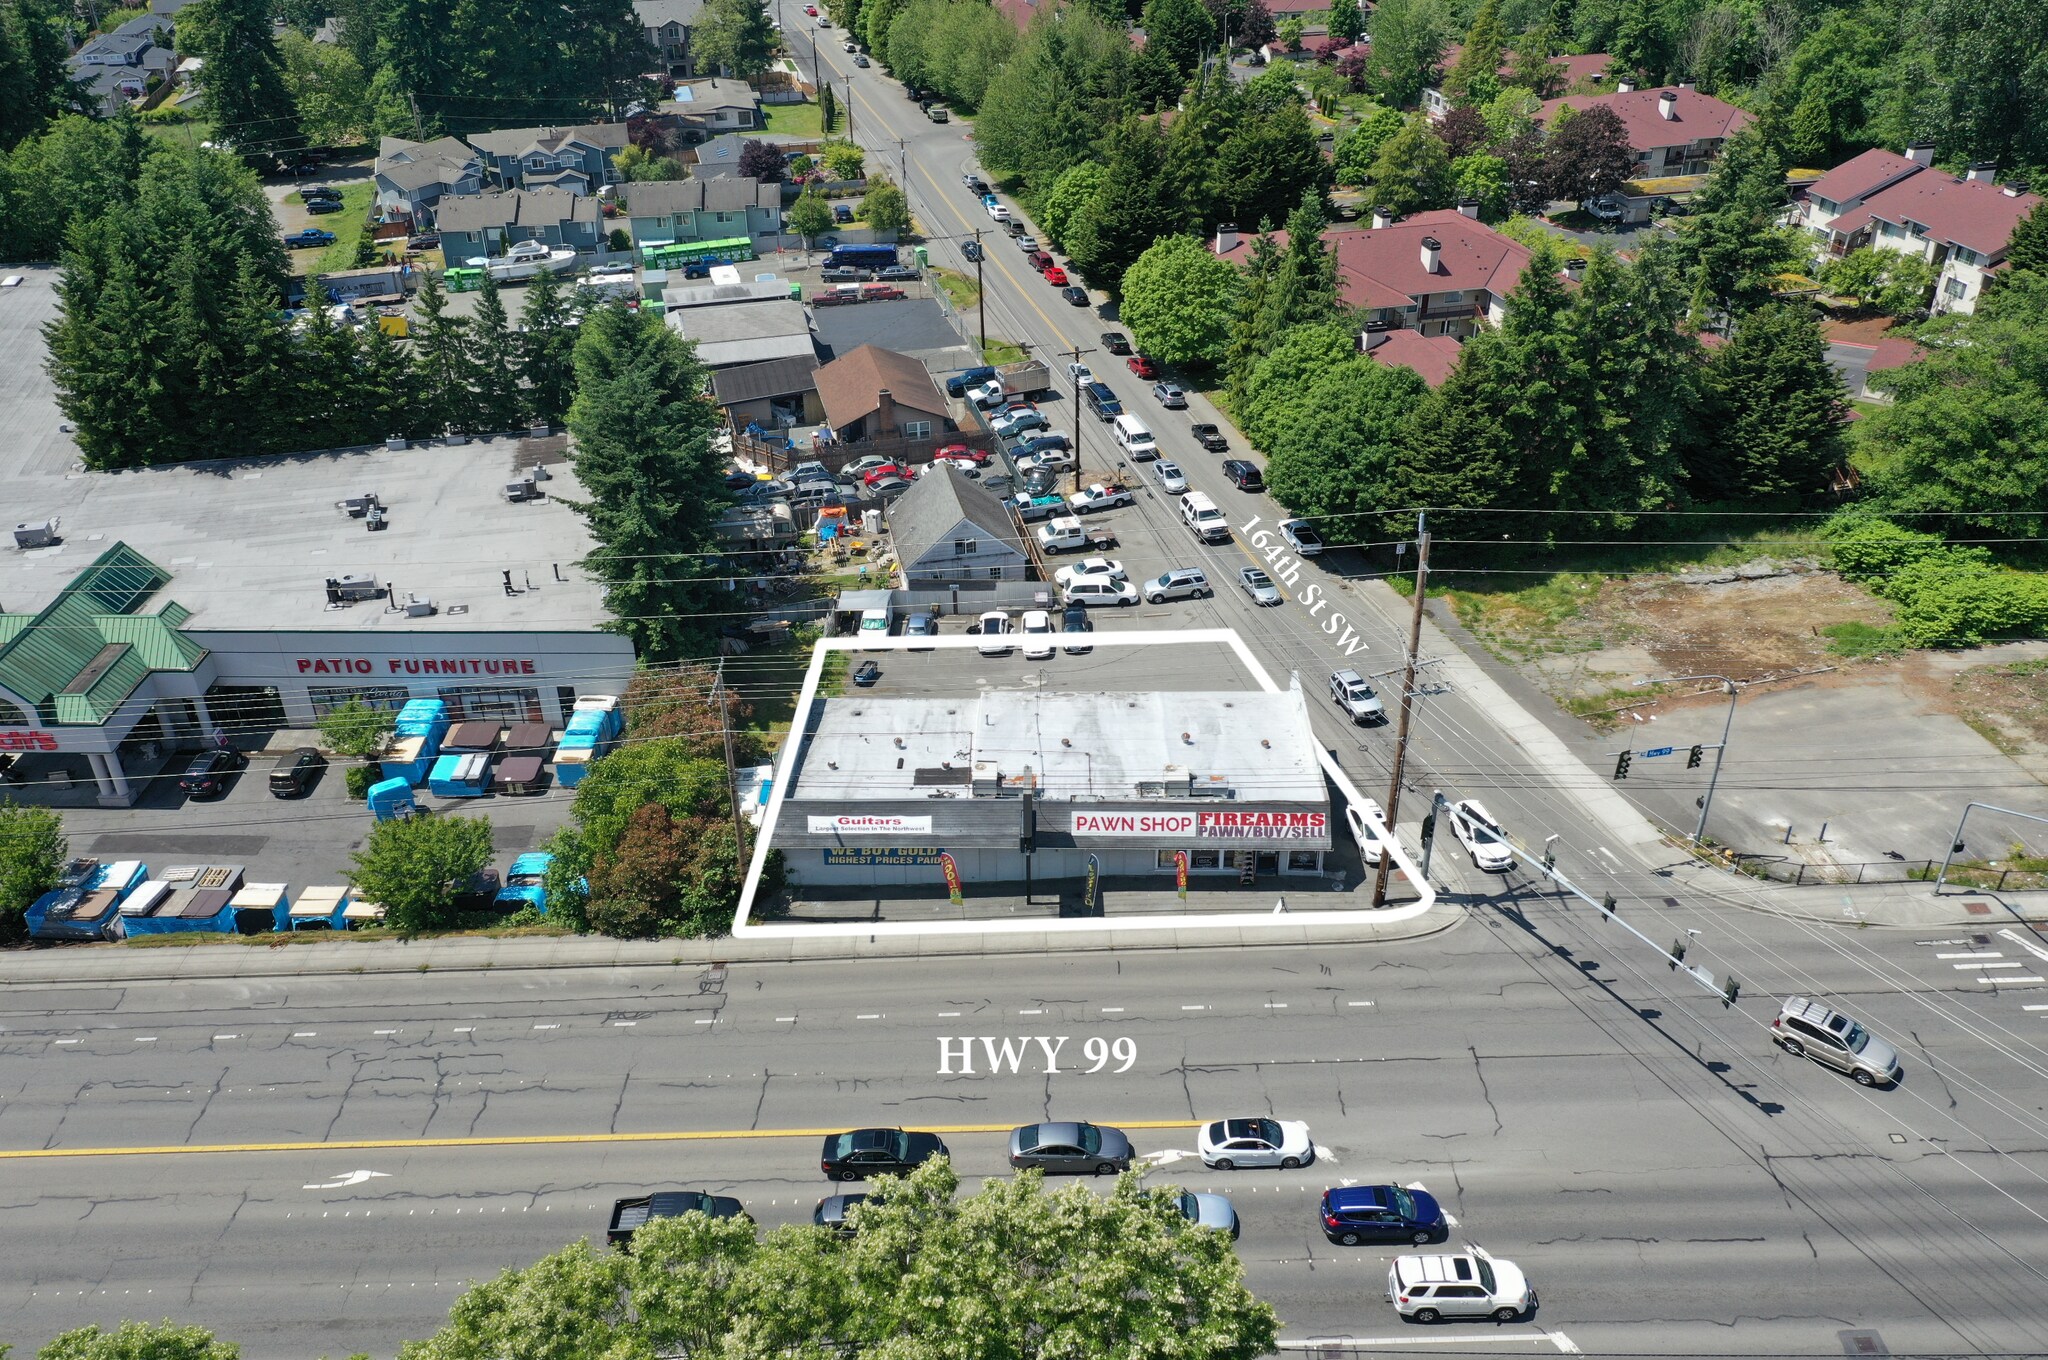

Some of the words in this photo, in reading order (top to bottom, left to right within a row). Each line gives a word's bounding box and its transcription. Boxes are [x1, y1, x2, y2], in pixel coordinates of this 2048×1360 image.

[297, 658, 372, 674] PATIO
[389, 658, 537, 674] FURNITURE
[838, 817, 902, 825] Guitars
[1076, 816, 1134, 831] PAWN
[1140, 817, 1192, 832] SHOP
[1199, 812, 1325, 827] FIREARMS
[1199, 826, 1325, 838] PAWN/BUY/SELL
[828, 856, 872, 864] HIGHEST
[875, 856, 913, 864] PRICES
[917, 856, 941, 864] PAID
